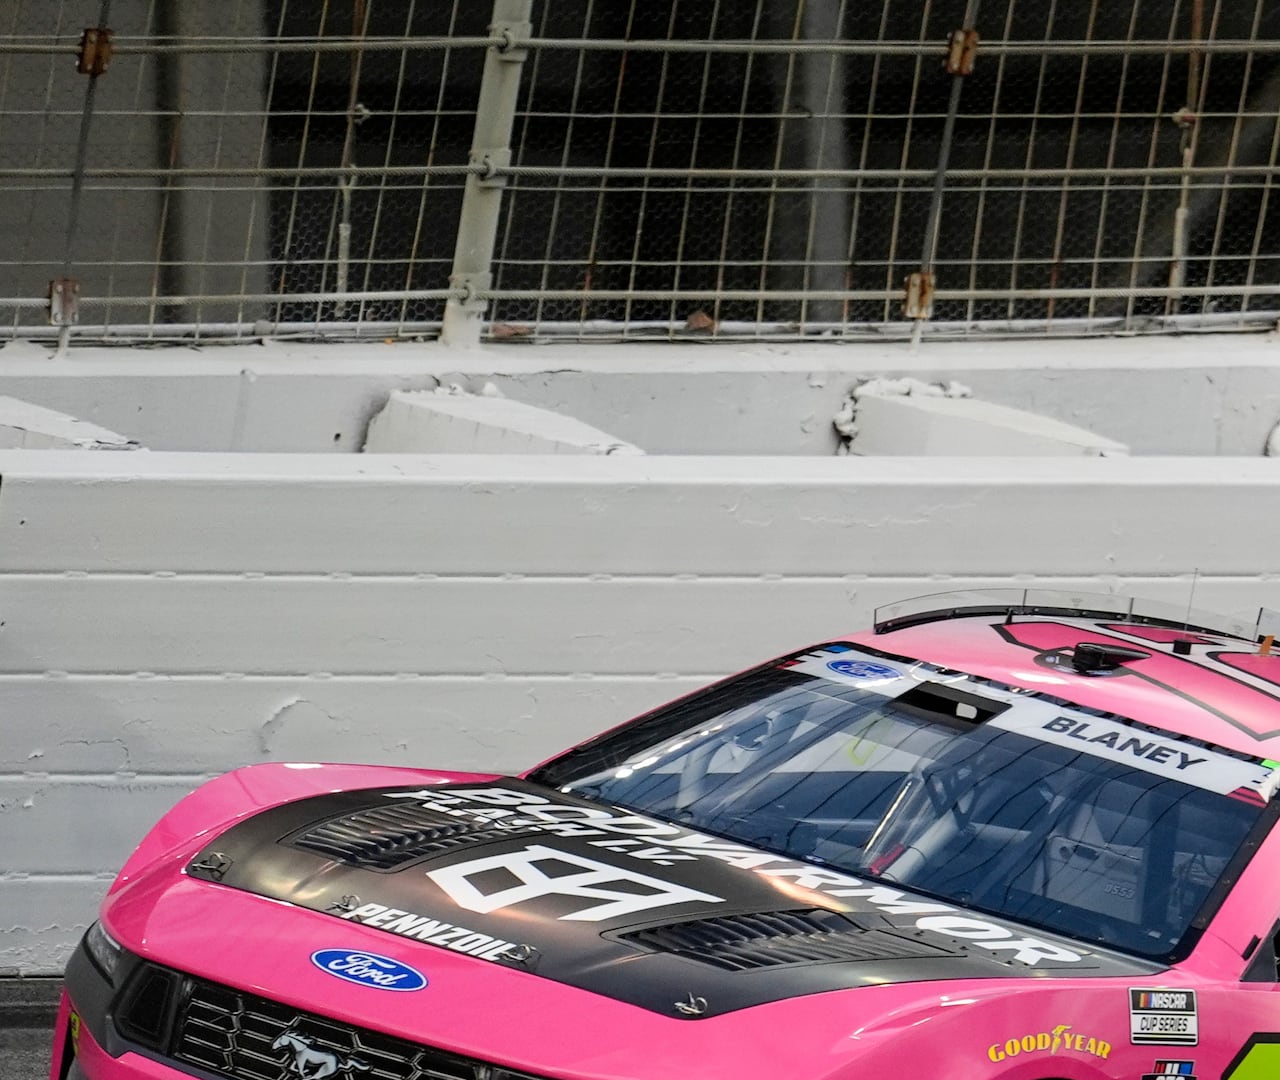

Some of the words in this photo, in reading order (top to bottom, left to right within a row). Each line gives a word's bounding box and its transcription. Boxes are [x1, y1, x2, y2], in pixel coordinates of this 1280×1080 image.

[1041, 716, 1207, 770] BLANEY
[447, 787, 1082, 966] BODYARMOR
[355, 902, 516, 961] PENNZOIL
[328, 954, 409, 986] Ford
[1150, 993, 1187, 1009] NASCAR
[1140, 1016, 1158, 1031] CUP
[1159, 1017, 1189, 1032] SERIES
[988, 1025, 1111, 1062] GOODYEAR
